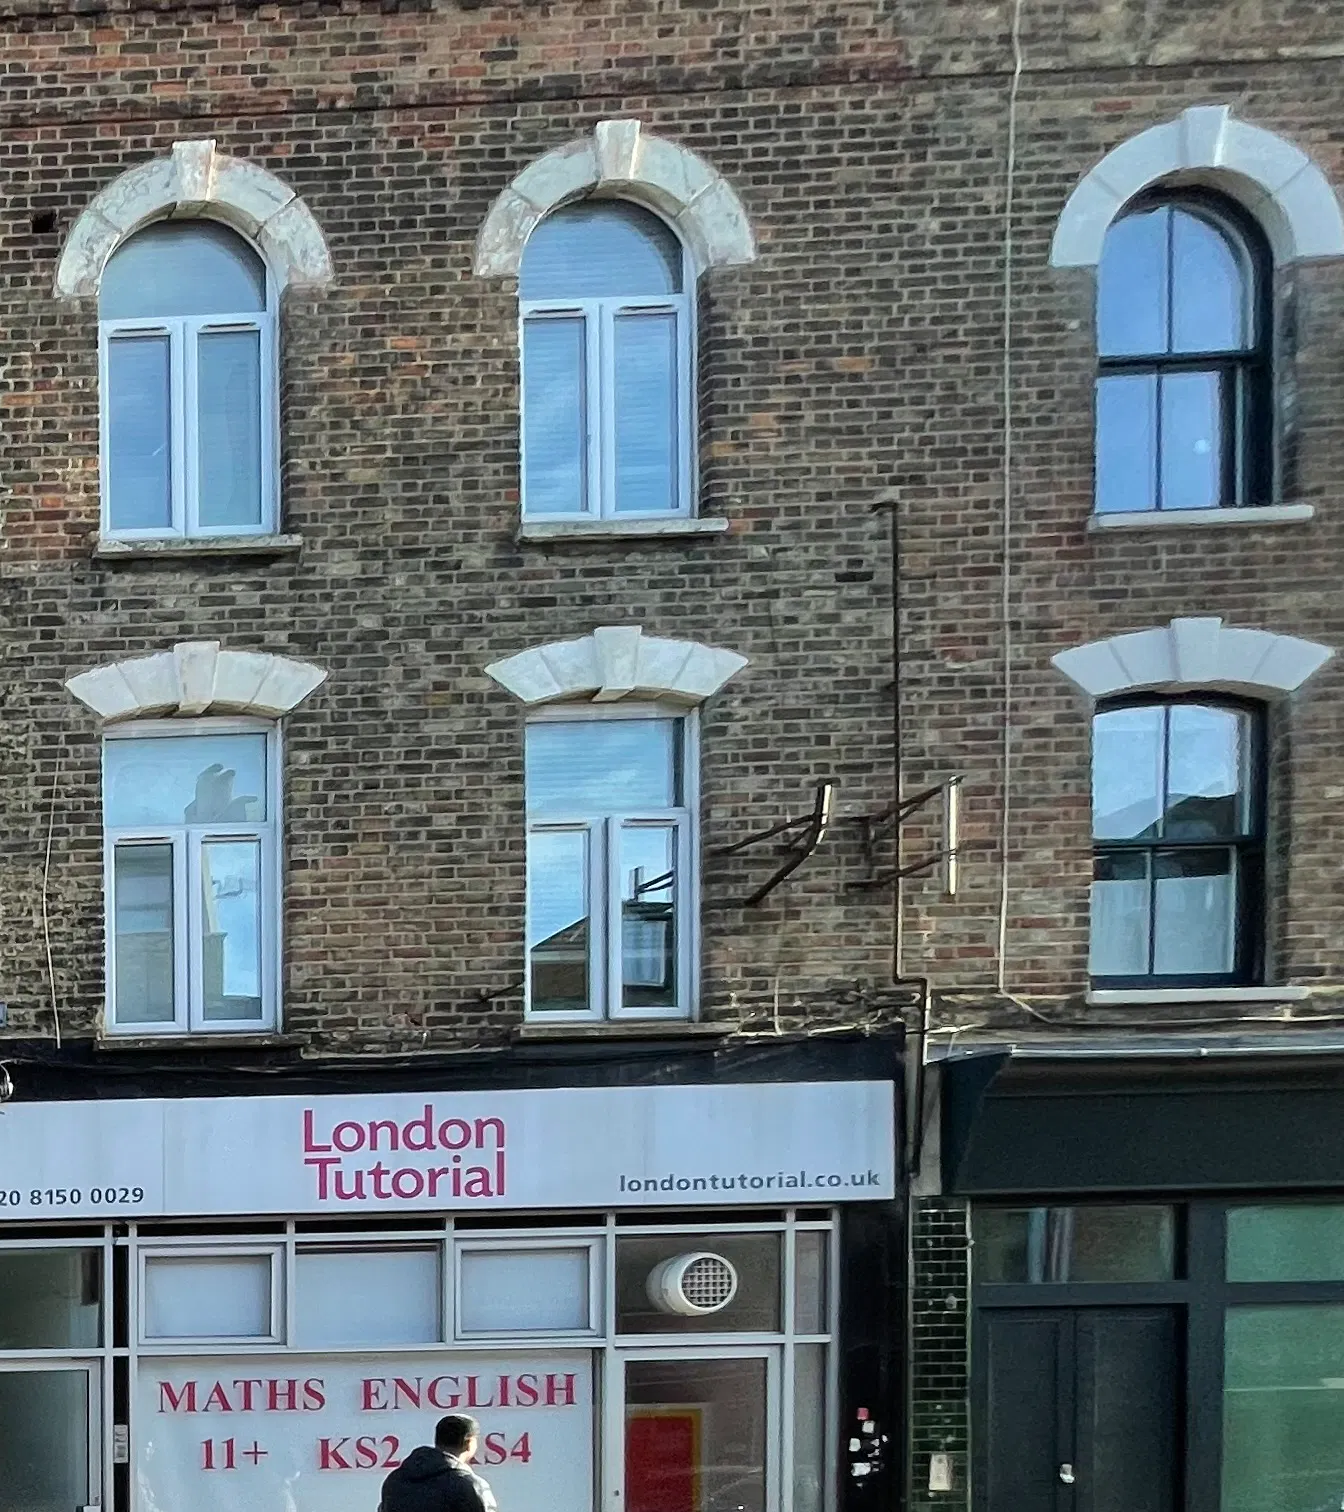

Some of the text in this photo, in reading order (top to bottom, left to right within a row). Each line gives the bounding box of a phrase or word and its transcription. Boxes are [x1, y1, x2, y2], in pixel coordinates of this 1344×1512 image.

[304, 1104, 505, 1152] London
[304, 1151, 505, 1200] Tutorial
[619, 1169, 881, 1193] londontutorial.co.uk
[29, 1188, 82, 1206] 8150
[90, 1186, 145, 1205] 0029
[157, 1373, 578, 1413] MATHS ENGLISH
[200, 1431, 532, 1470] 11+ KS2 S4
